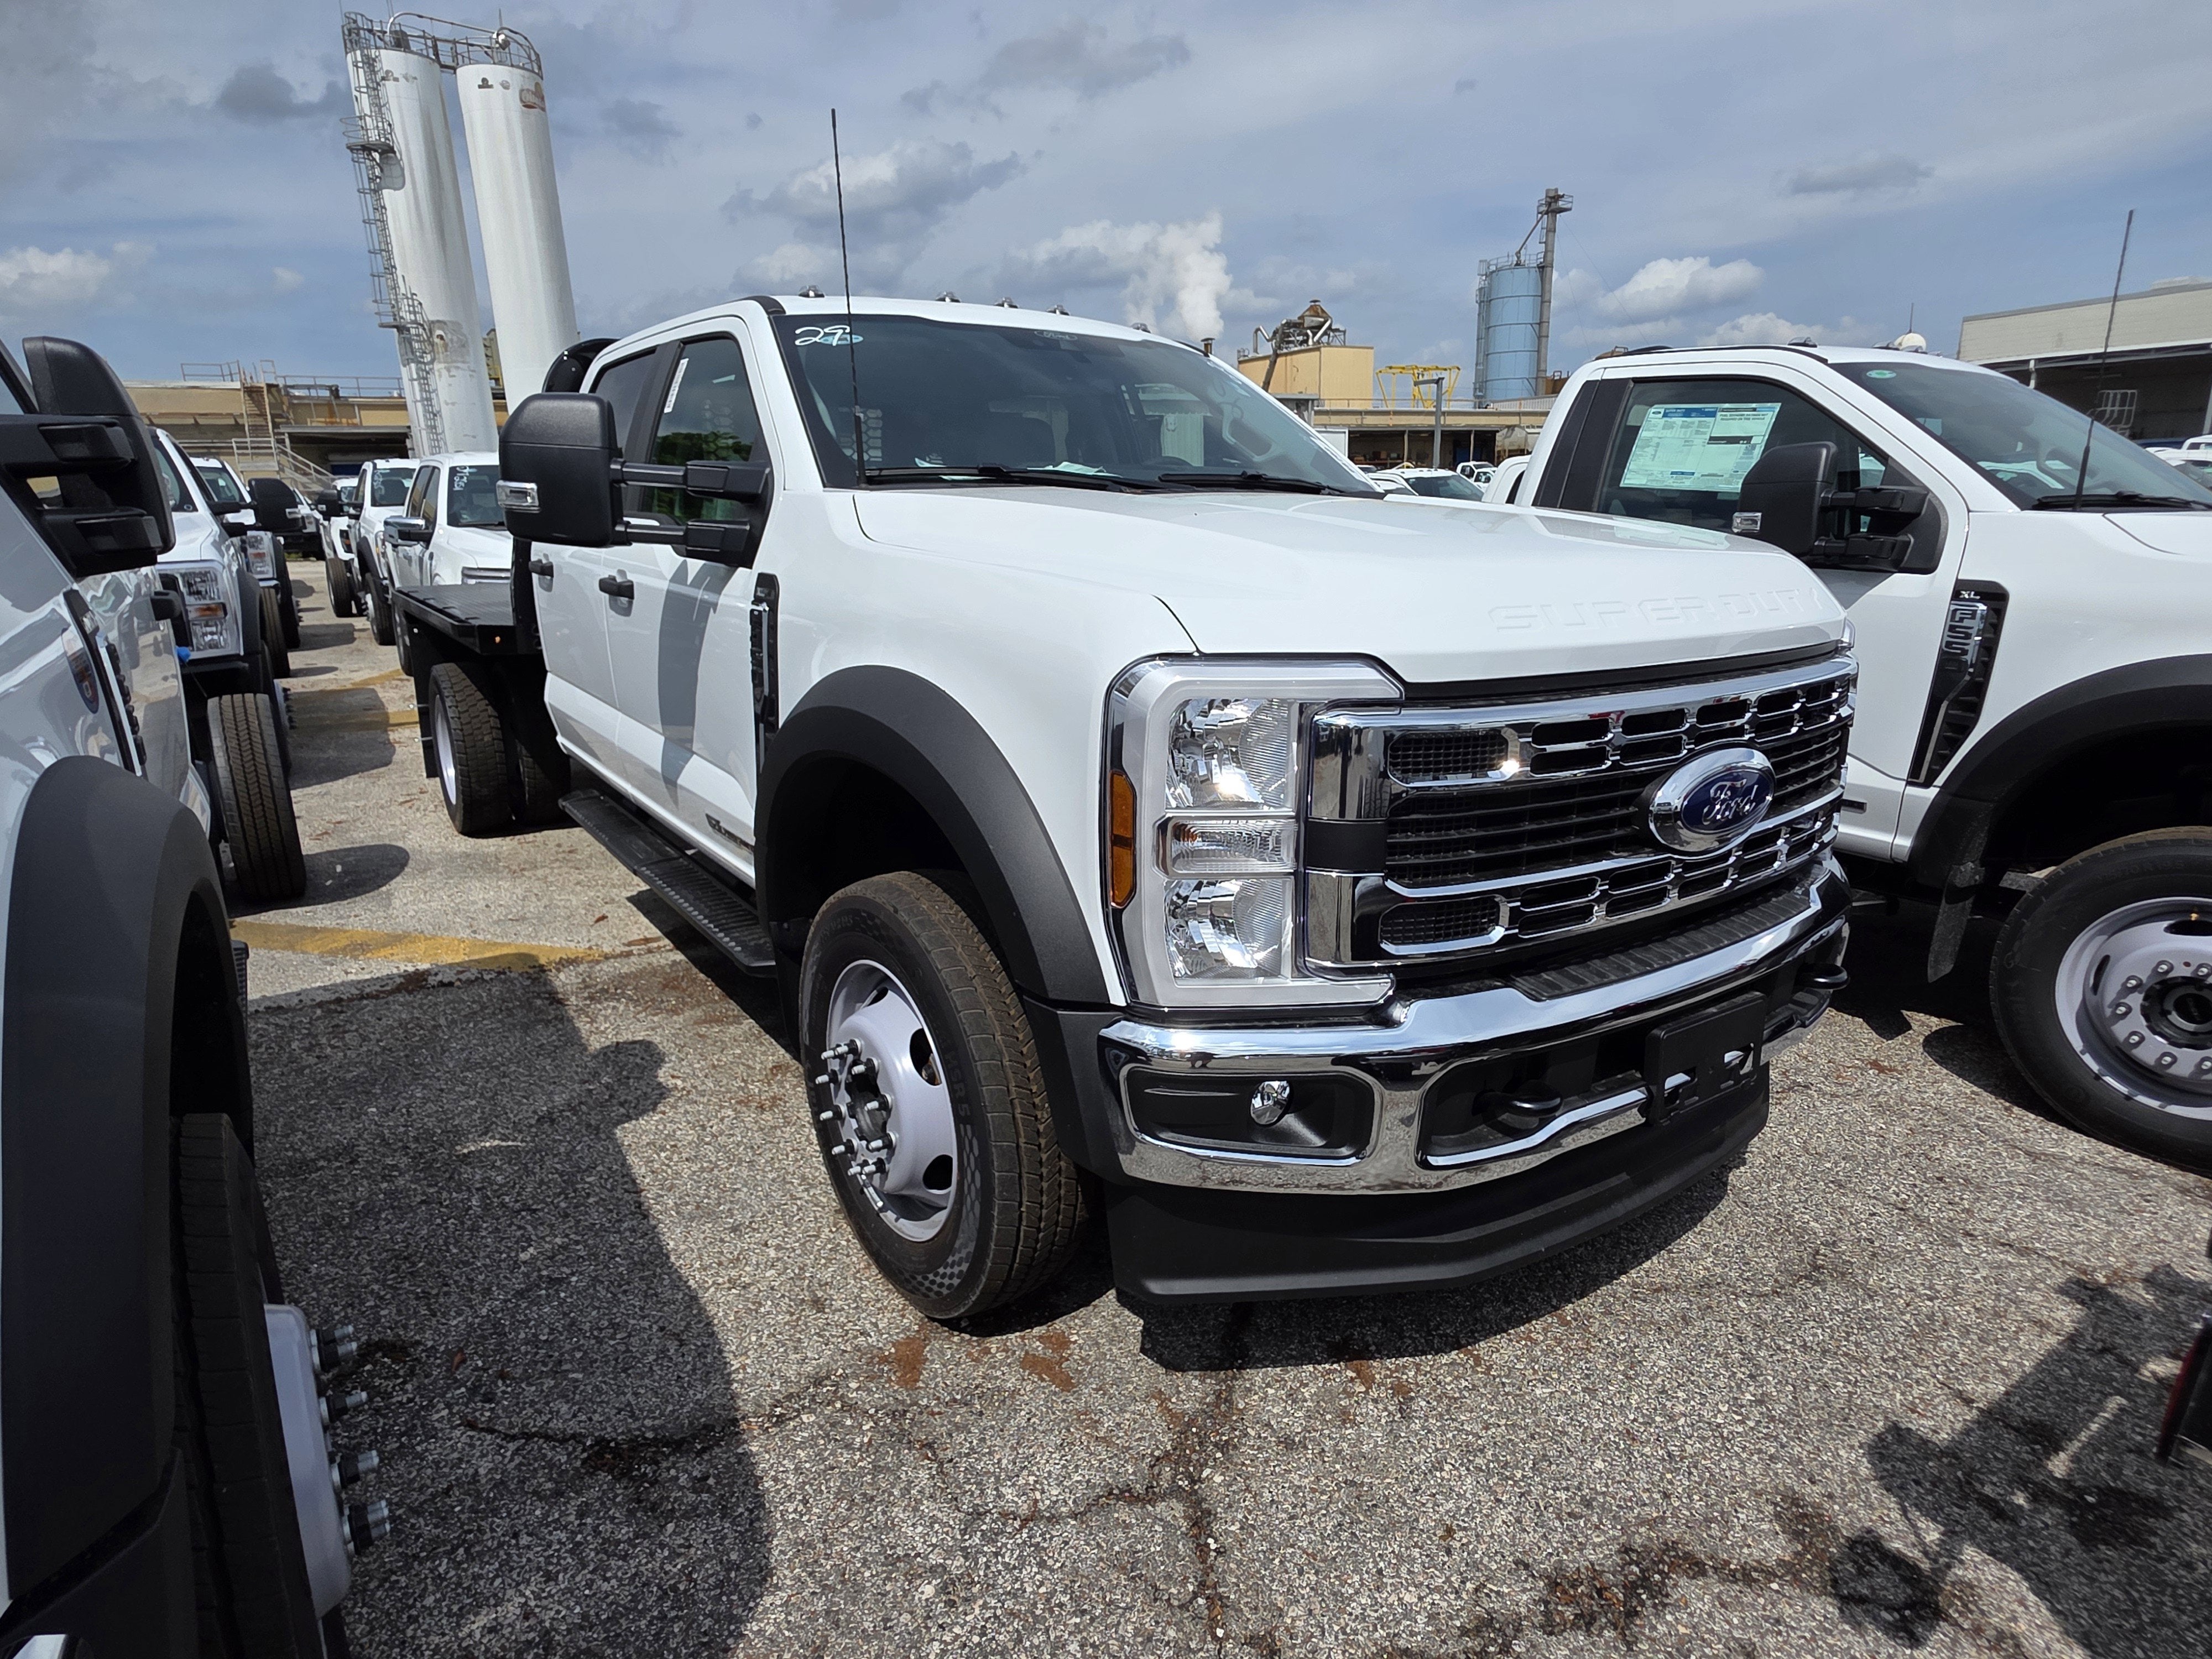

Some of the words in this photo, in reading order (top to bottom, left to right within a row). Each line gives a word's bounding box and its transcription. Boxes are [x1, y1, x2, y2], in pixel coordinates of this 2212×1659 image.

[1488, 596, 1719, 634] SUPER
[1718, 587, 1823, 617] DUTY
[1958, 589, 1981, 600] XL
[1702, 778, 1759, 826] Ford
